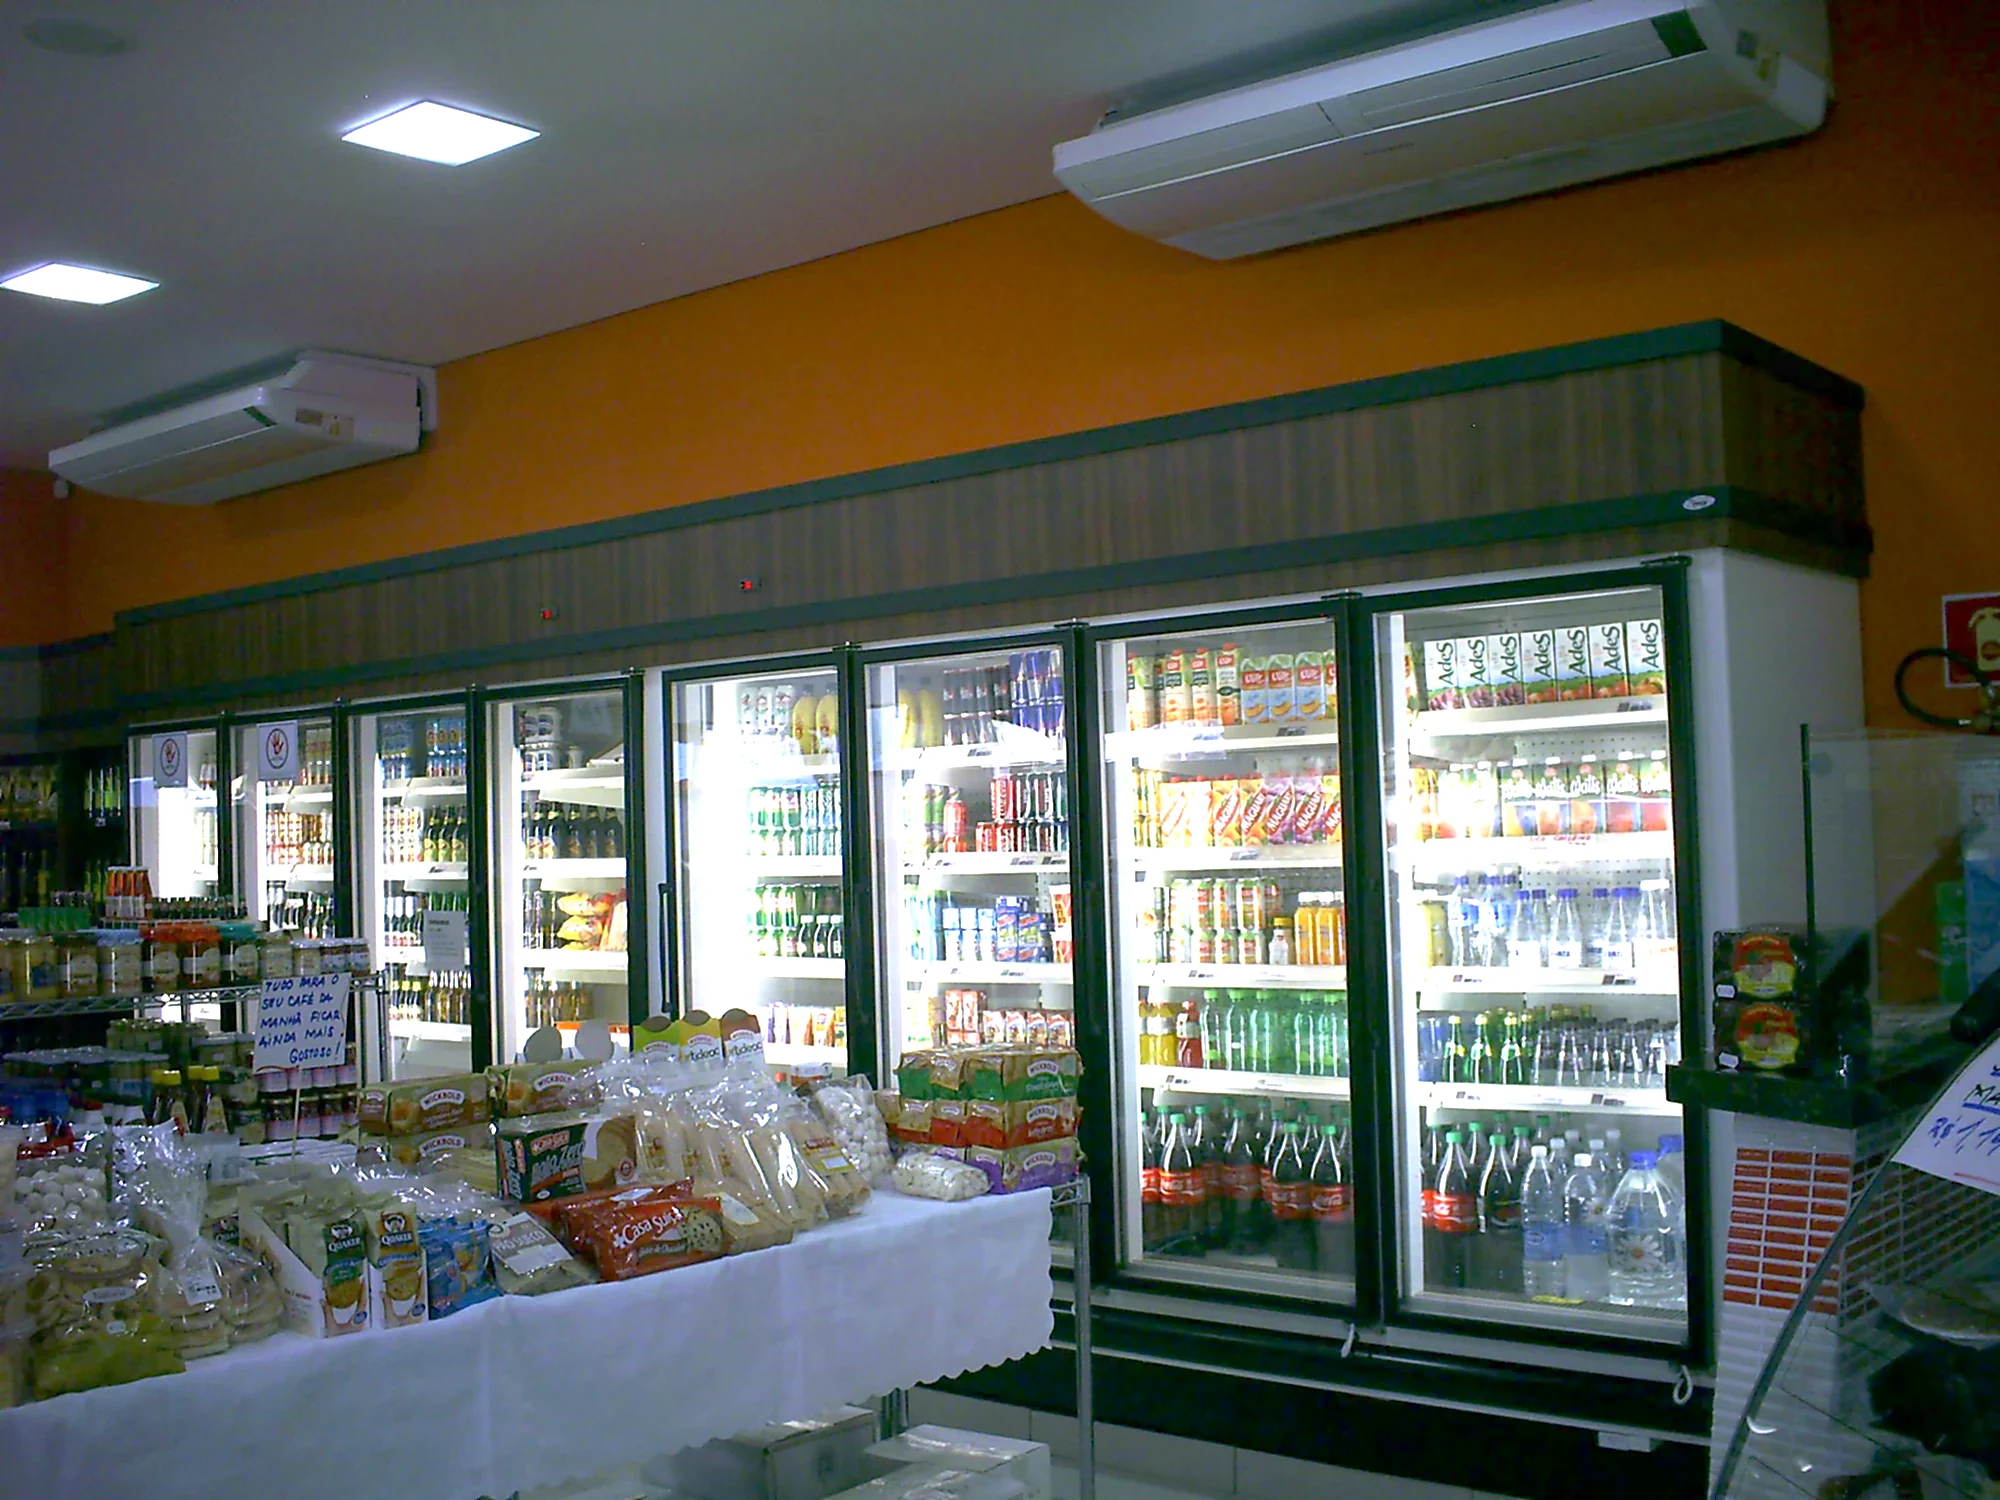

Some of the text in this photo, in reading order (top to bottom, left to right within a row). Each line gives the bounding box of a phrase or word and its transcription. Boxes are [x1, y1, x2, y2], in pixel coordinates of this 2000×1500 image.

[1468, 639, 1486, 683] AdeS
[1500, 635, 1519, 681] AdeS
[1533, 633, 1552, 678] AdeS
[1567, 629, 1586, 675] AdeS
[1601, 625, 1622, 672] AdeS
[1640, 621, 1660, 669] AdeS
[1436, 641, 1454, 686] AdeS
[261, 991, 333, 1010] SEU CAFÉ DA
[265, 974, 339, 992] TUDO PARA O
[260, 1009, 341, 1028] MANHÃ FICAR
[305, 1025, 335, 1039] MAIS
[328, 1236, 361, 1253] QUAKER
[380, 1232, 413, 1248] QUAKER
[621, 1219, 653, 1245] Casa
